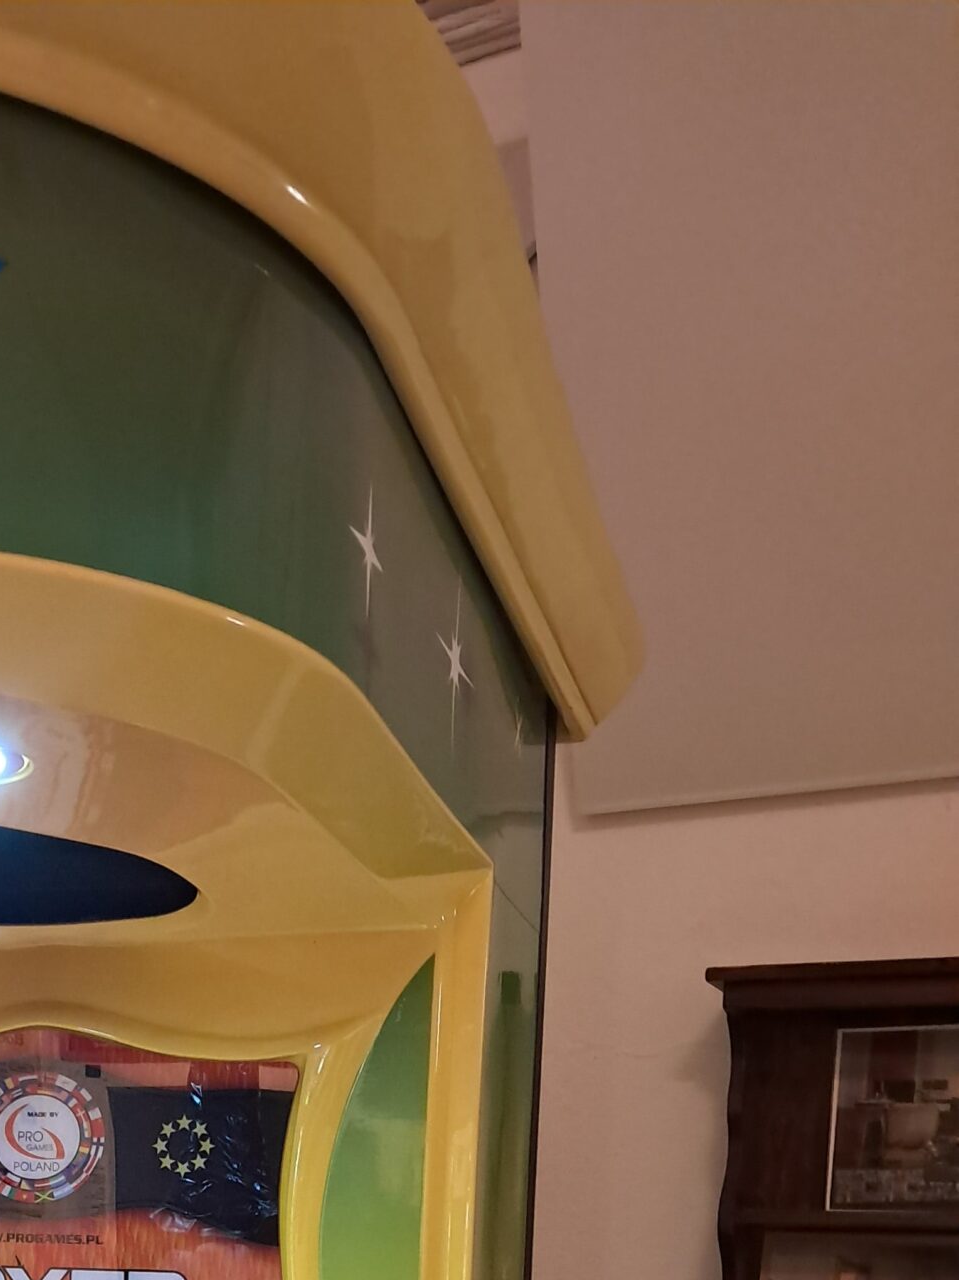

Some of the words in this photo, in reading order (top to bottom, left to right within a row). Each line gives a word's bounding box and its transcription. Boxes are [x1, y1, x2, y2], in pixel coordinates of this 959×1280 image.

[18, 1131, 44, 1143] PRO
[26, 1143, 54, 1152] GAMES
[13, 1161, 60, 1173] POLAND
